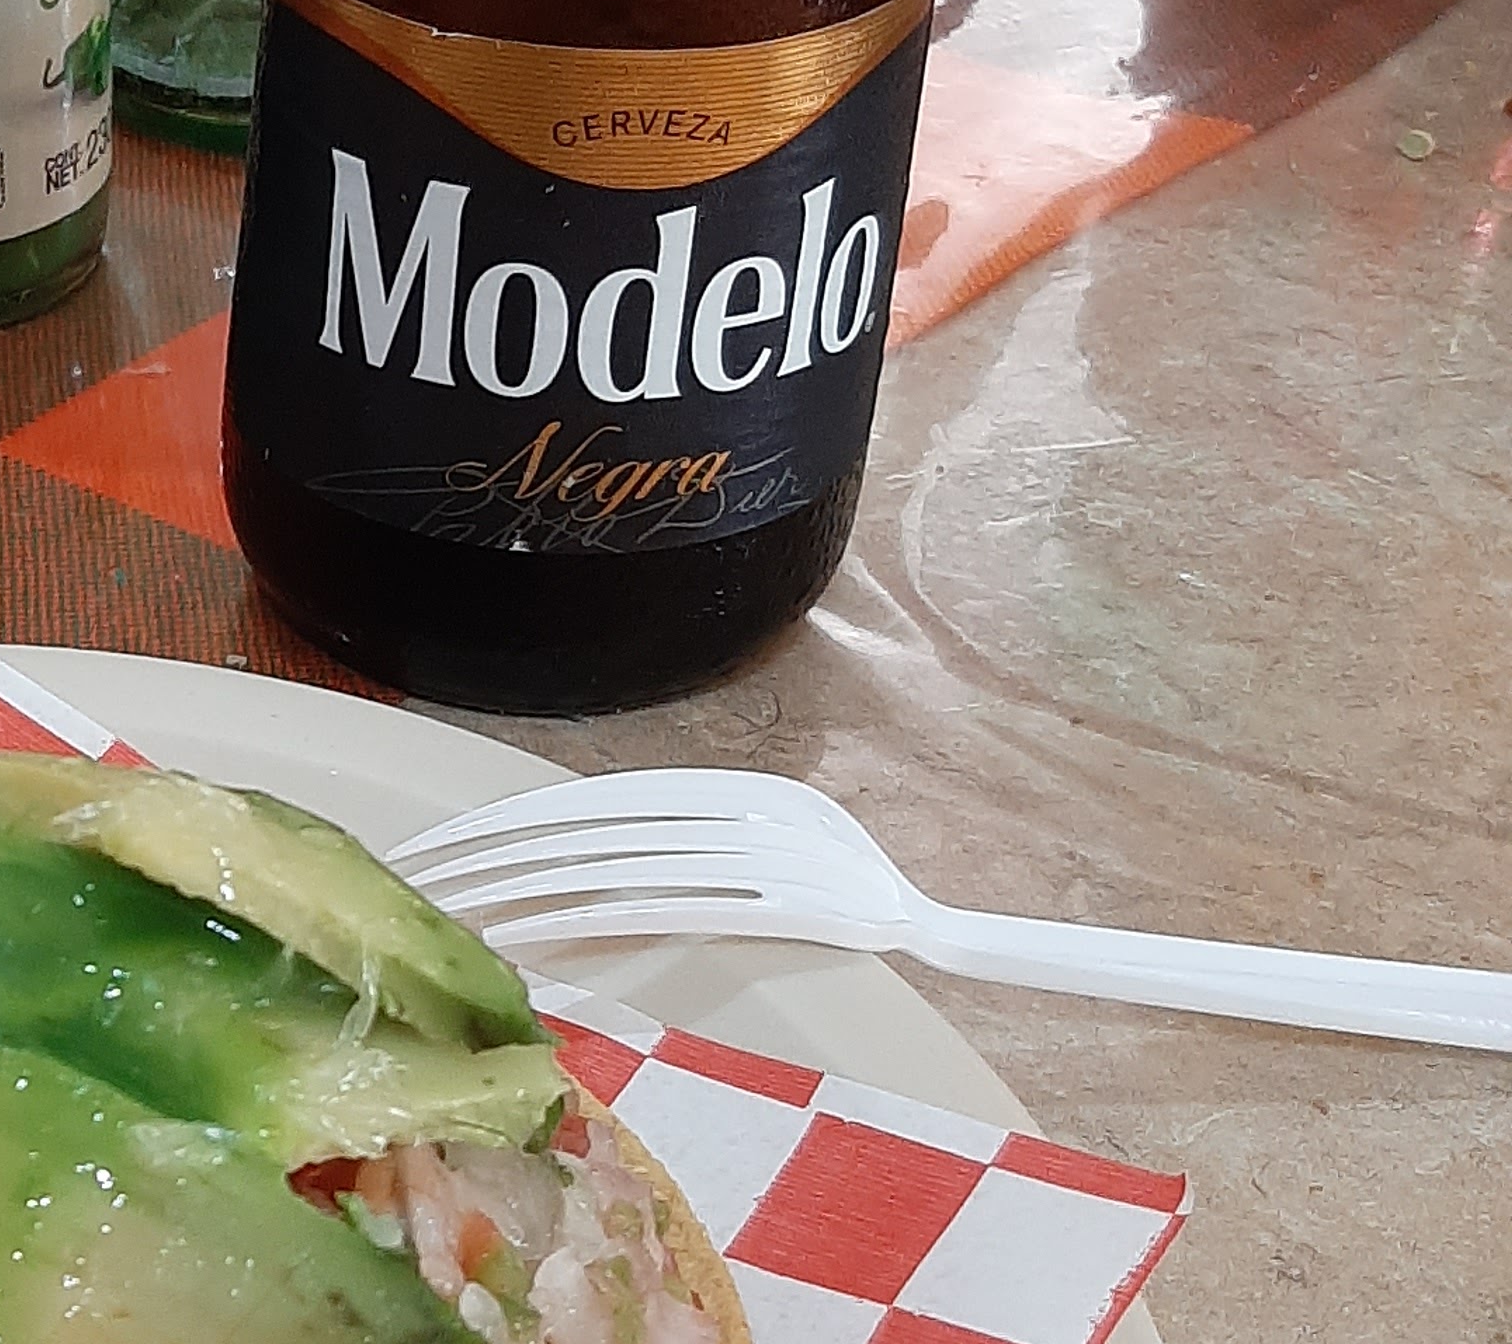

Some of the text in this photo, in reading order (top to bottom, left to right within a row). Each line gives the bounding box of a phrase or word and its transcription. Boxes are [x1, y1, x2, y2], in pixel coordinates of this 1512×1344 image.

[551, 107, 733, 147] CERVEZA
[318, 147, 881, 404] Modelo
[446, 421, 731, 520] Negra
